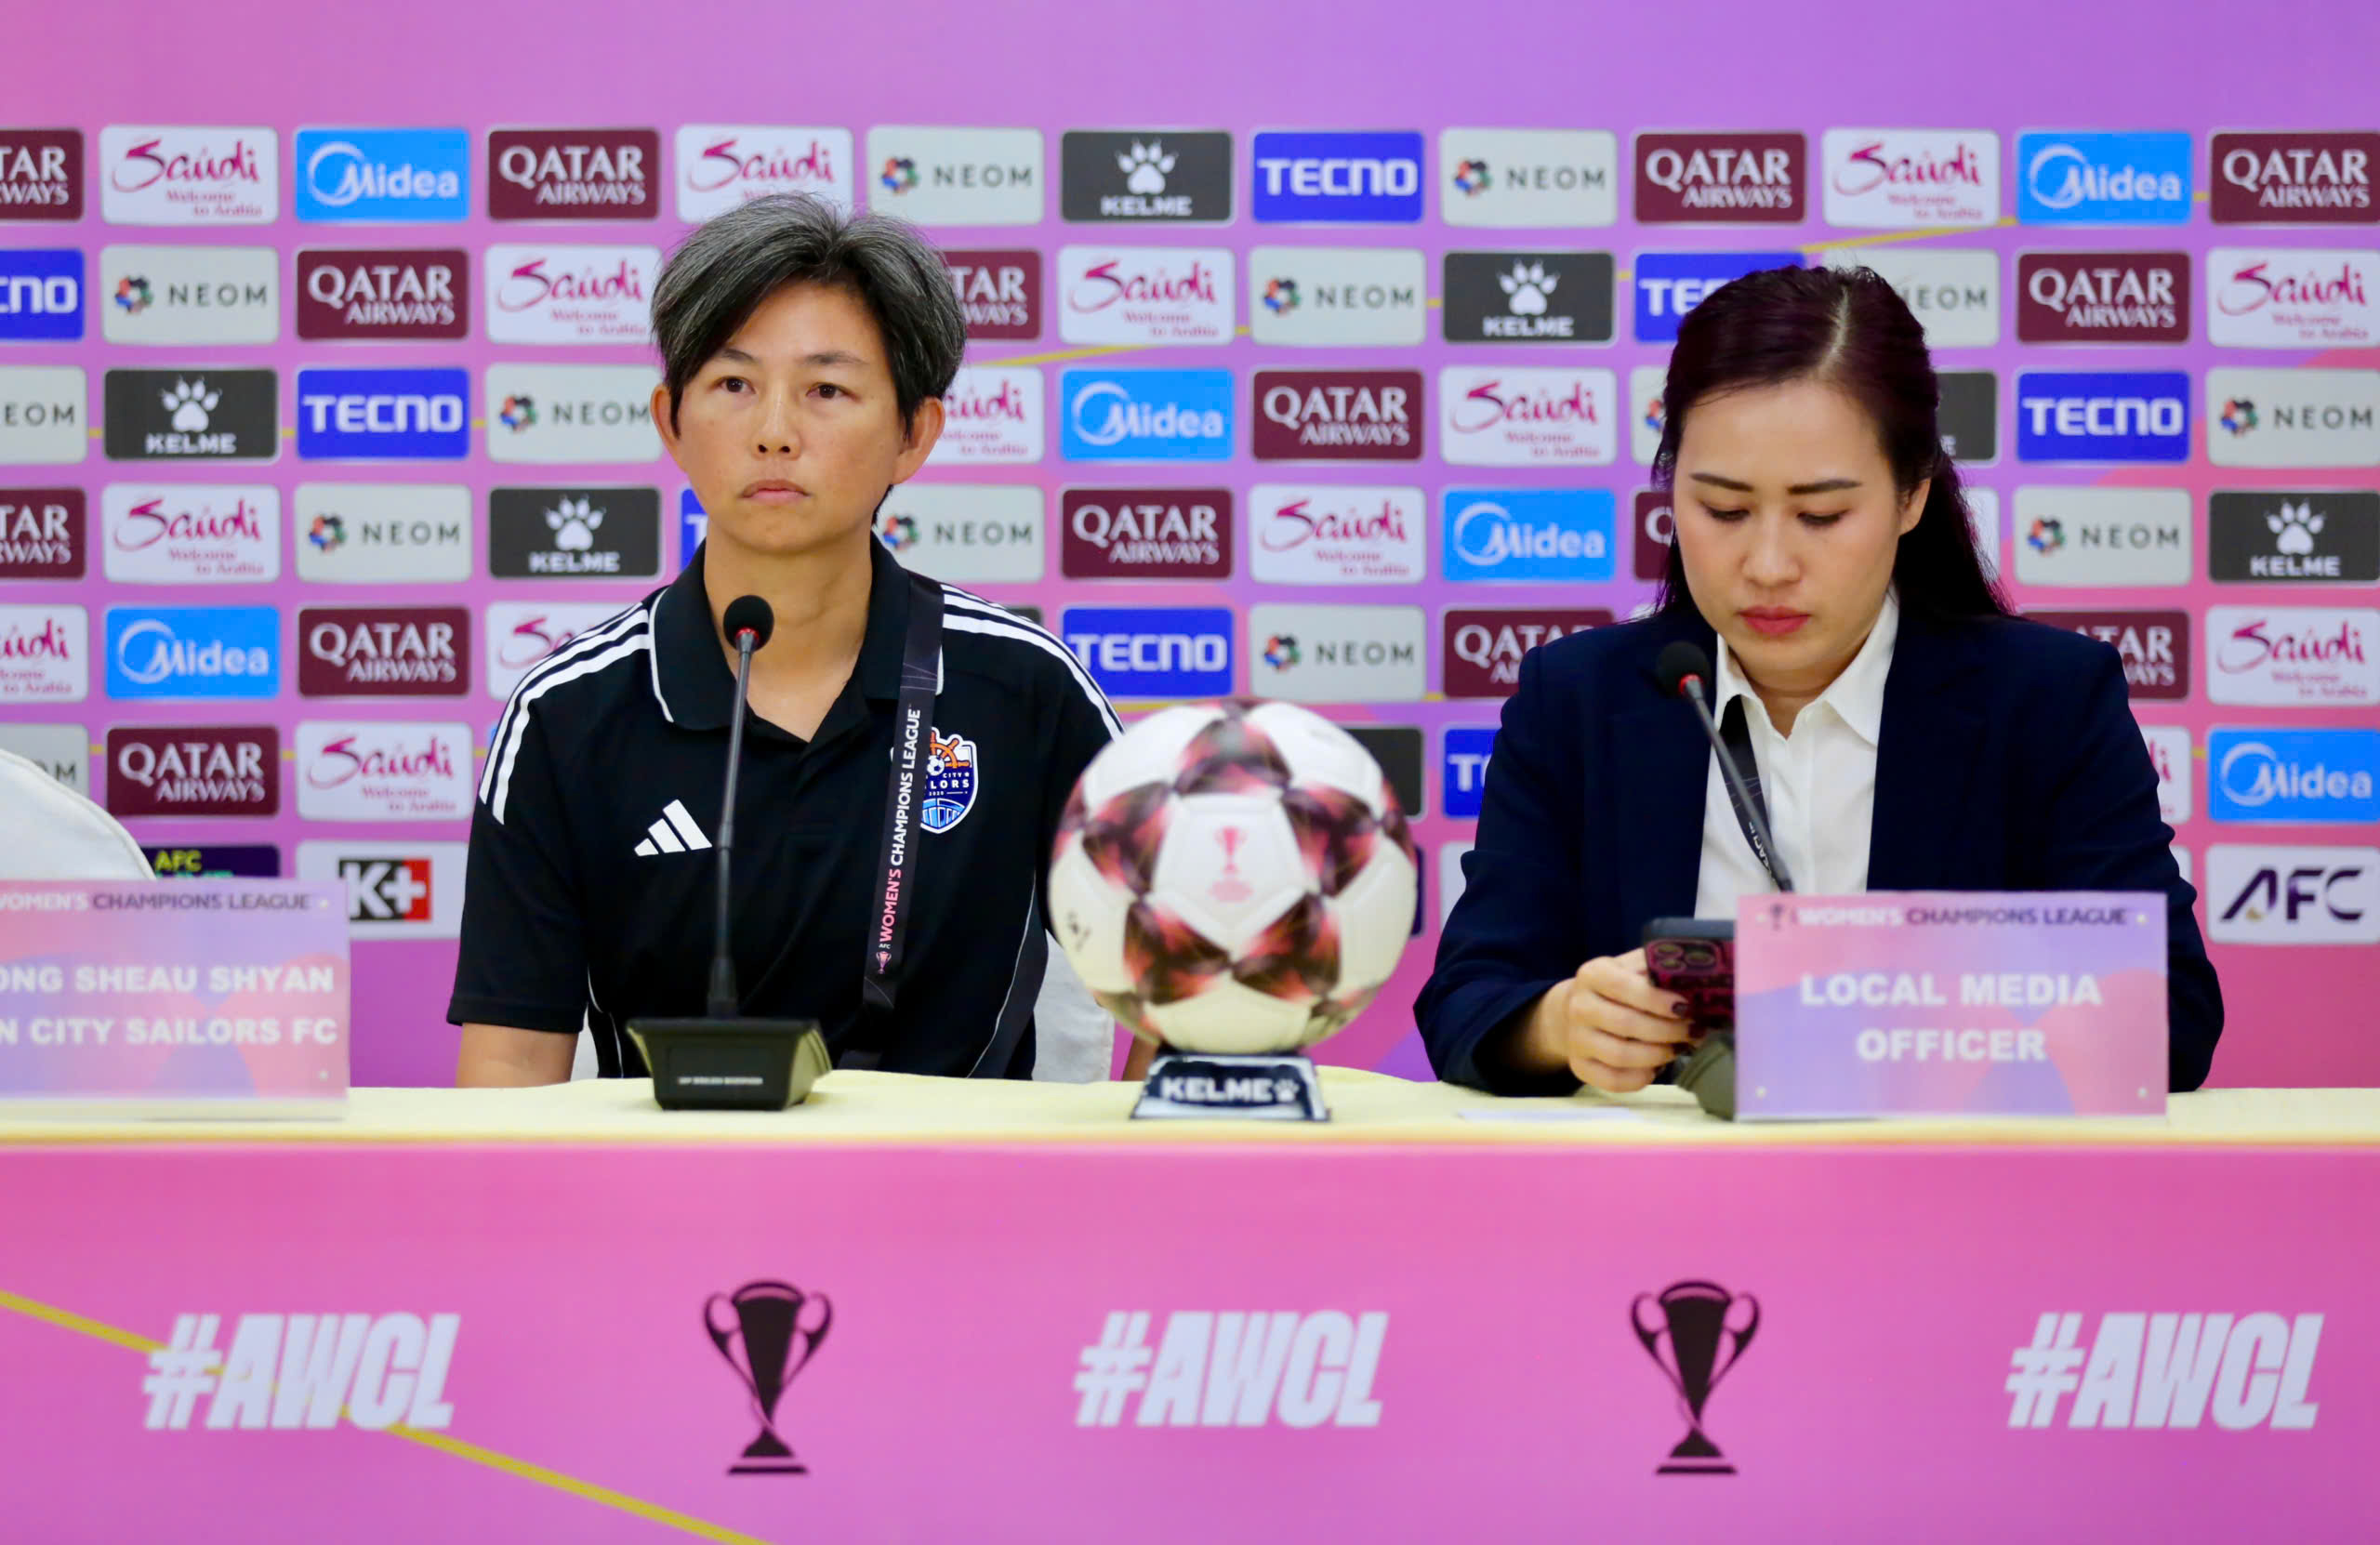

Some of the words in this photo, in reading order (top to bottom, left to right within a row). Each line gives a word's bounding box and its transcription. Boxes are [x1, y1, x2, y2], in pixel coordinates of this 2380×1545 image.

[0, 145, 68, 181] TAR
[498, 145, 645, 190] QATAR
[934, 163, 1034, 187] NEOM
[1257, 157, 1419, 196] TECNO
[1645, 149, 1792, 193] QATAR
[2222, 149, 2369, 193] QATAR
[335, 161, 459, 198] Midea
[1507, 165, 1606, 190] NEOM
[2056, 164, 2181, 201] Midea
[0, 181, 70, 205] WAYS
[536, 182, 646, 205] AIRWAYS
[1101, 195, 1193, 217] KELME
[1683, 186, 1792, 208] AIRWAYS
[2260, 186, 2370, 208] AIRWAYS
[168, 283, 268, 307] NEOM
[307, 265, 454, 310] QATAR
[946, 265, 1028, 303] TAR
[1316, 284, 1415, 309] NEOM
[2029, 268, 2175, 312] QATAR
[345, 302, 455, 324] AIRWAYS
[961, 302, 1029, 325] WAYS
[1483, 316, 1575, 337] KELME
[2067, 305, 2176, 327] AIRWAYS
[4, 403, 75, 427] EOM
[302, 394, 464, 433] TECNO
[552, 401, 652, 425] NEOM
[1100, 401, 1224, 438] Midea
[1263, 386, 1409, 430] QATAR
[2022, 397, 2184, 436] TECNO
[2274, 405, 2373, 429] NEOM
[145, 433, 237, 455] KELME
[1301, 423, 1410, 445] AIRWAYS
[0, 504, 71, 541] TAR
[362, 521, 461, 545] NEOM
[934, 521, 1034, 545] NEOM
[1072, 504, 1219, 548] QATAR
[2081, 524, 2180, 548] NEOM
[0, 540, 73, 564] WAYS
[1110, 541, 1220, 563] AIRWAYS
[1481, 521, 1606, 558] Midea
[529, 552, 621, 574] KELME
[2250, 556, 2342, 577] KELME
[145, 639, 270, 676] Midea
[309, 623, 456, 667] QATAR
[1065, 632, 1228, 671] TECNO
[1316, 640, 1416, 665] NEOM
[1453, 624, 1593, 668] QAT
[347, 660, 456, 682] AIRWAYS
[903, 708, 921, 770] LEAGUE
[117, 742, 264, 786] QATAR
[155, 779, 265, 801] AIRWAYS
[924, 779, 970, 789] LORS
[2248, 761, 2373, 799] Midea
[890, 772, 914, 867] CHAMPIONS
[154, 849, 202, 872] AFC
[92, 892, 222, 911] CHAMPIONS
[228, 892, 310, 911] LEAGUE
[879, 868, 902, 942] WOMEN'S
[2219, 867, 2365, 922] AFC
[1906, 907, 2038, 926] CHAMPIONS
[2043, 907, 2127, 926] LEAGUE
[75, 966, 197, 993] SHEAU
[210, 966, 334, 993] SHYAN
[1800, 973, 1948, 1007] LOCAL
[1959, 973, 2103, 1007] MEDIA
[31, 1018, 115, 1044] CITY
[126, 1018, 282, 1045] SAILORS
[291, 1018, 338, 1045] FC
[1856, 1028, 2048, 1062] OFFICER
[1160, 1076, 1275, 1102] KELME
[143, 1312, 461, 1431] #AWCL
[1074, 1309, 1391, 1429] #AWCL
[2004, 1312, 2325, 1431] #AWCL
